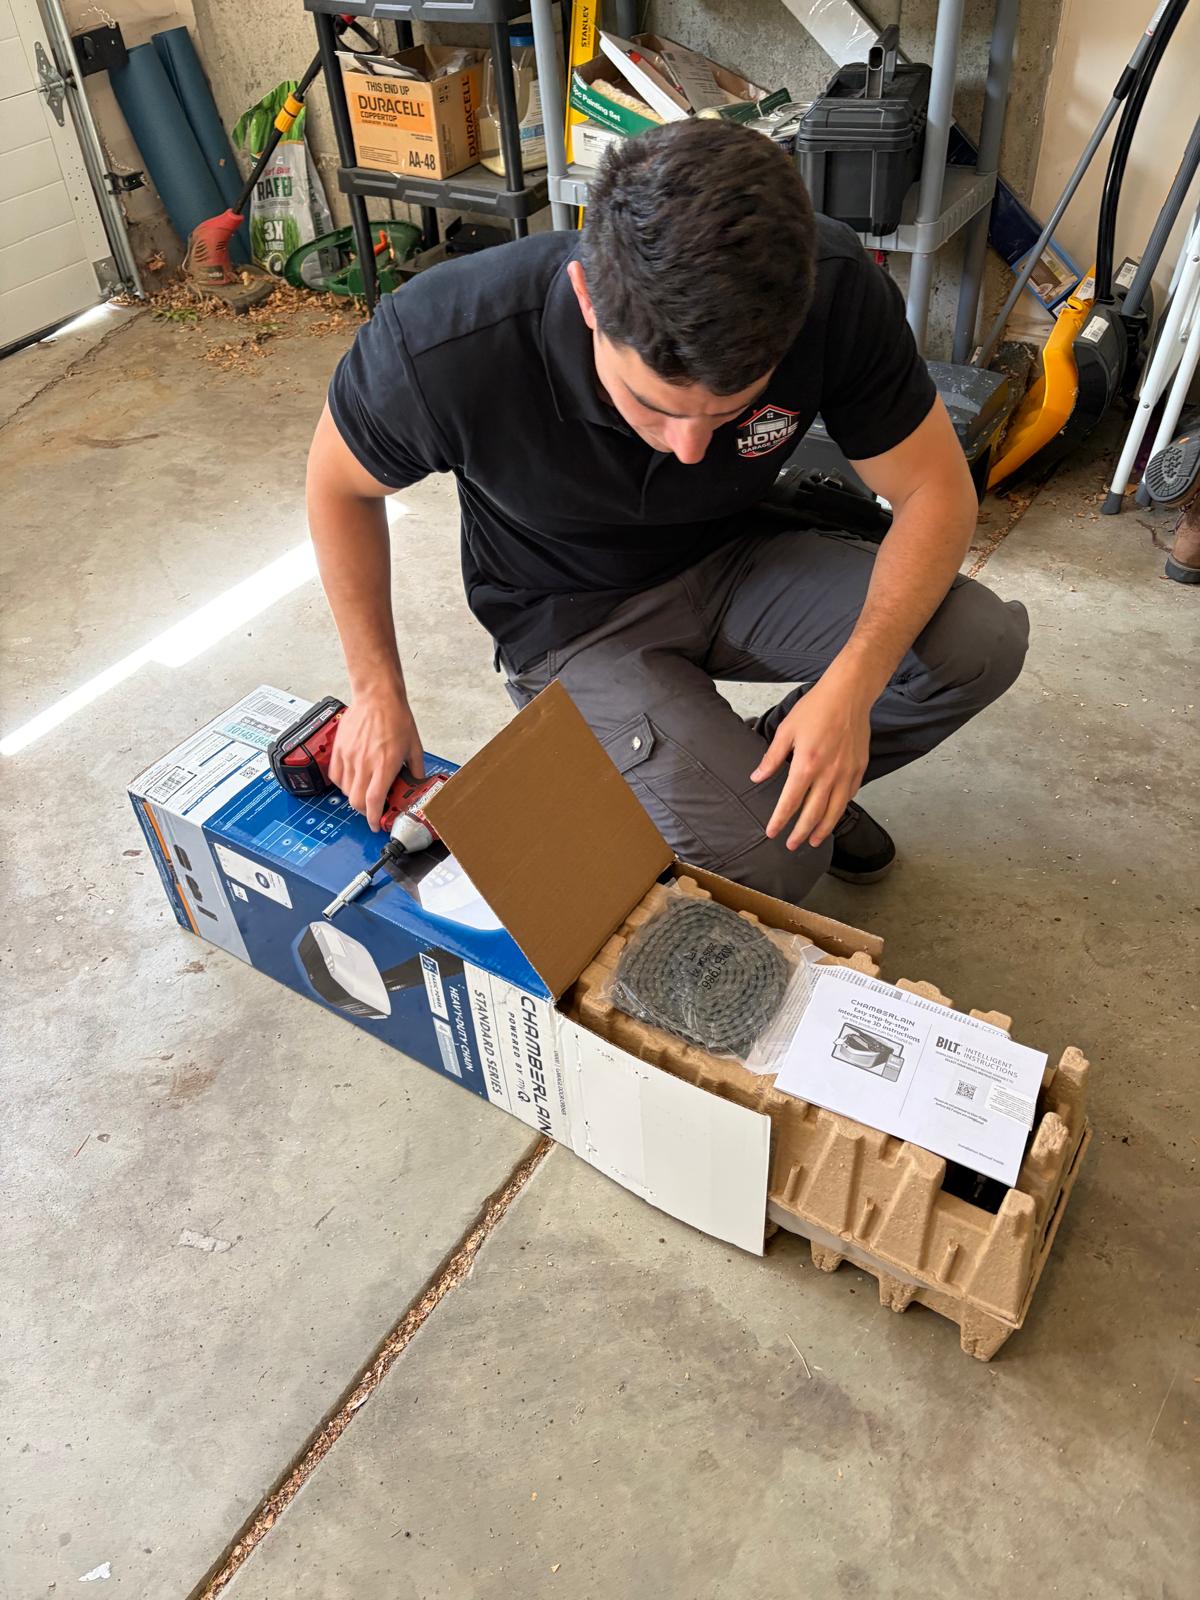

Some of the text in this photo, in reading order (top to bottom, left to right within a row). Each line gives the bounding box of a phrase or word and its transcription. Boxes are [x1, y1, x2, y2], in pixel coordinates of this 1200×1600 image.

[581, 6, 589, 48] STANLEY
[366, 81, 410, 95] THIS END UP
[358, 95, 425, 117] DURACELL
[361, 111, 397, 121] COPPERTOP
[462, 76, 477, 158] DURACELL
[581, 93, 609, 115] Painting
[409, 150, 436, 170] AA-48
[264, 220, 284, 241] 3X
[850, 998, 915, 1026] CHAMBERLAIN
[853, 1007, 908, 1032] Easy step-by-step
[449, 985, 468, 1044] HEAVY-DUTY
[462, 1043, 474, 1072] CHAIN
[837, 1008, 871, 1024] interactive
[882, 1024, 920, 1043] instructions
[474, 990, 502, 1095] STANDARD SERIES
[508, 1011, 520, 1058] POWERED
[516, 1064, 523, 1075] BY
[521, 995, 552, 1136] CHAMBERLAIN
[963, 1052, 1018, 1078] INSTRUCTIONS
[965, 1047, 1012, 1068] INTELLIGENT
